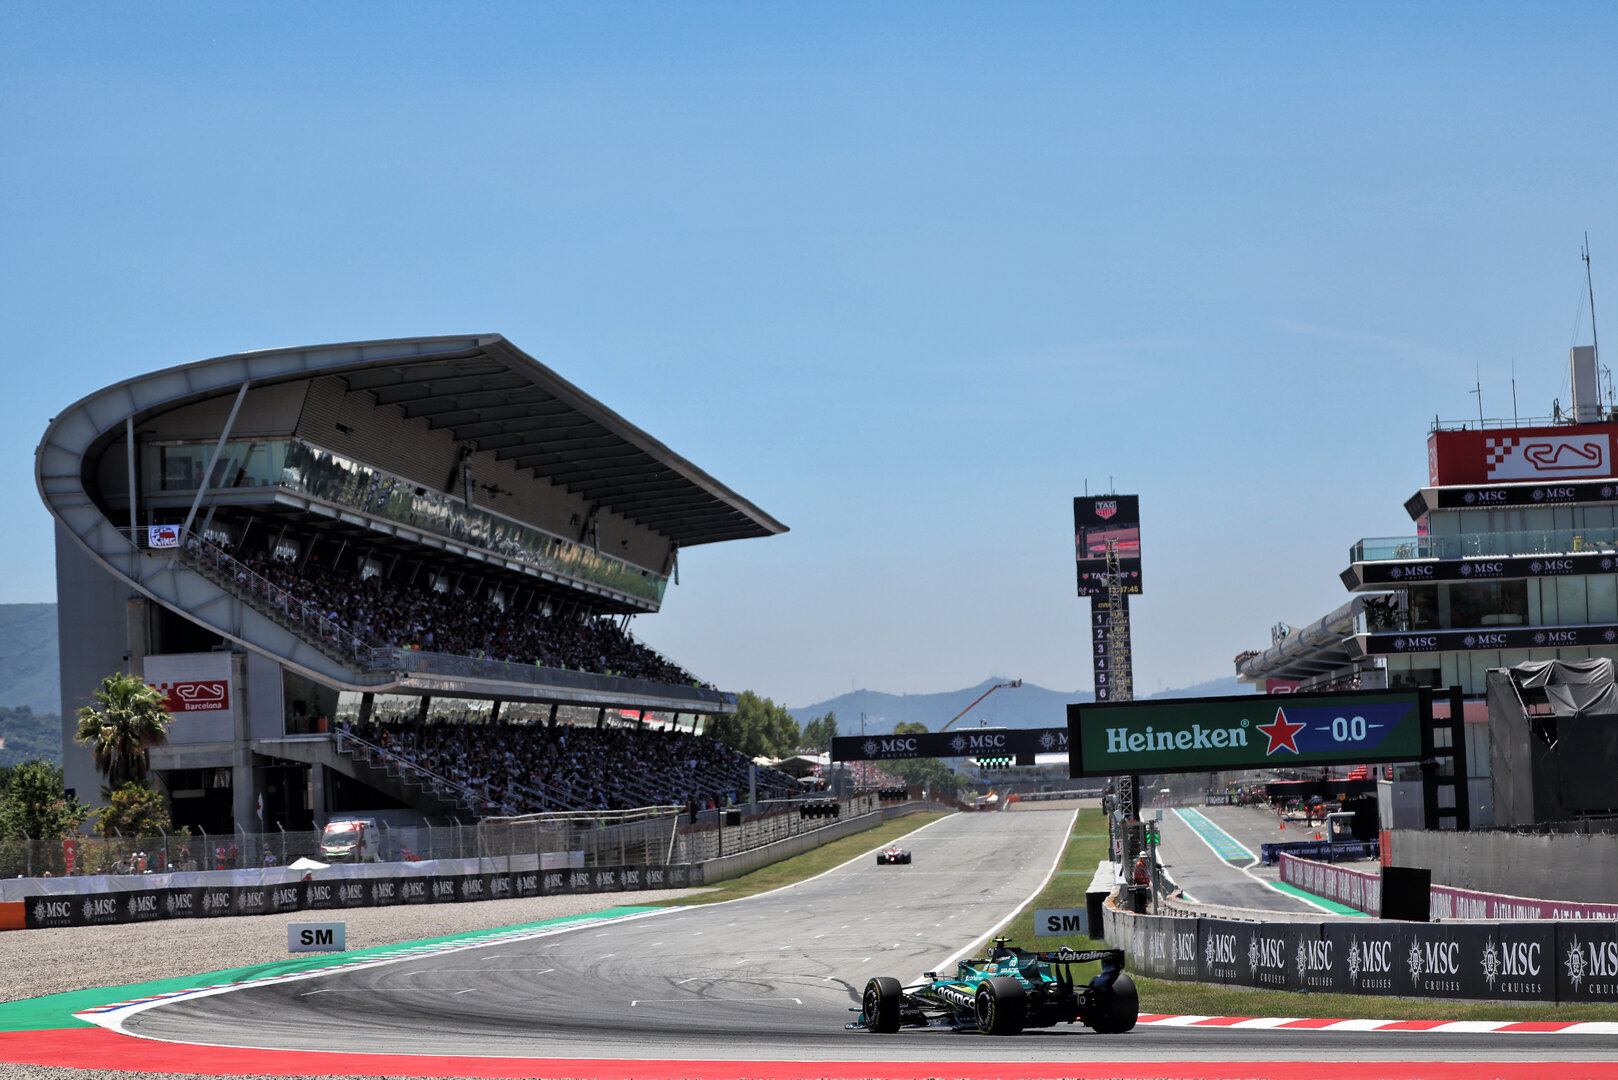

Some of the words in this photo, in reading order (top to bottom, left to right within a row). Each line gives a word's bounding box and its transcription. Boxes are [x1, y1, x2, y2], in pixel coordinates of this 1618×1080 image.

[1478, 490, 1506, 500] MSC
[1546, 488, 1575, 498] MSC
[1404, 566, 1434, 576] MSC
[1475, 562, 1503, 573] MSC
[1544, 560, 1573, 570] MSC
[1097, 614, 1102, 624] 1
[1097, 630, 1104, 638] 2
[1478, 634, 1506, 644] MSC
[1548, 631, 1576, 642] MSC
[1408, 637, 1437, 647] MSC
[1098, 645, 1104, 653] 3
[1098, 660, 1104, 668] 4
[1100, 674, 1106, 682] 5
[1100, 689, 1106, 698] 6
[184, 702, 222, 710] Barcelona
[1106, 724, 1248, 752] Heineken
[1332, 716, 1366, 742] 0.0
[881, 738, 918, 752] MSC
[969, 734, 1006, 748] MSC
[314, 886, 330, 900] MSC
[347, 884, 362, 898] MSC
[378, 883, 394, 896] MSC
[409, 882, 424, 896] MSC
[440, 881, 454, 894] MSC
[175, 894, 192, 908] MSC
[212, 892, 230, 908] MSC
[247, 892, 264, 906] MSC
[280, 888, 298, 904] MSC
[46, 902, 70, 917] MSC
[94, 899, 116, 916] MSC
[138, 896, 156, 911] MSC
[1048, 916, 1080, 932] SM
[300, 930, 332, 946] SM
[1178, 934, 1194, 960] MSC
[1216, 934, 1236, 964] MSC
[1260, 938, 1284, 968] MSC
[1308, 940, 1332, 970] MSC
[1362, 941, 1392, 972] MSC
[1425, 941, 1460, 975] MSC
[1502, 942, 1540, 976] MSC
[1215, 968, 1236, 978] CRUISES
[1260, 974, 1285, 984] CRUISES
[1308, 976, 1332, 986] CRUISES
[1362, 978, 1392, 988] CRUISES
[1425, 980, 1460, 991] CRUISES
[1502, 982, 1541, 993] CRUISES
[938, 986, 975, 1009] aramco
